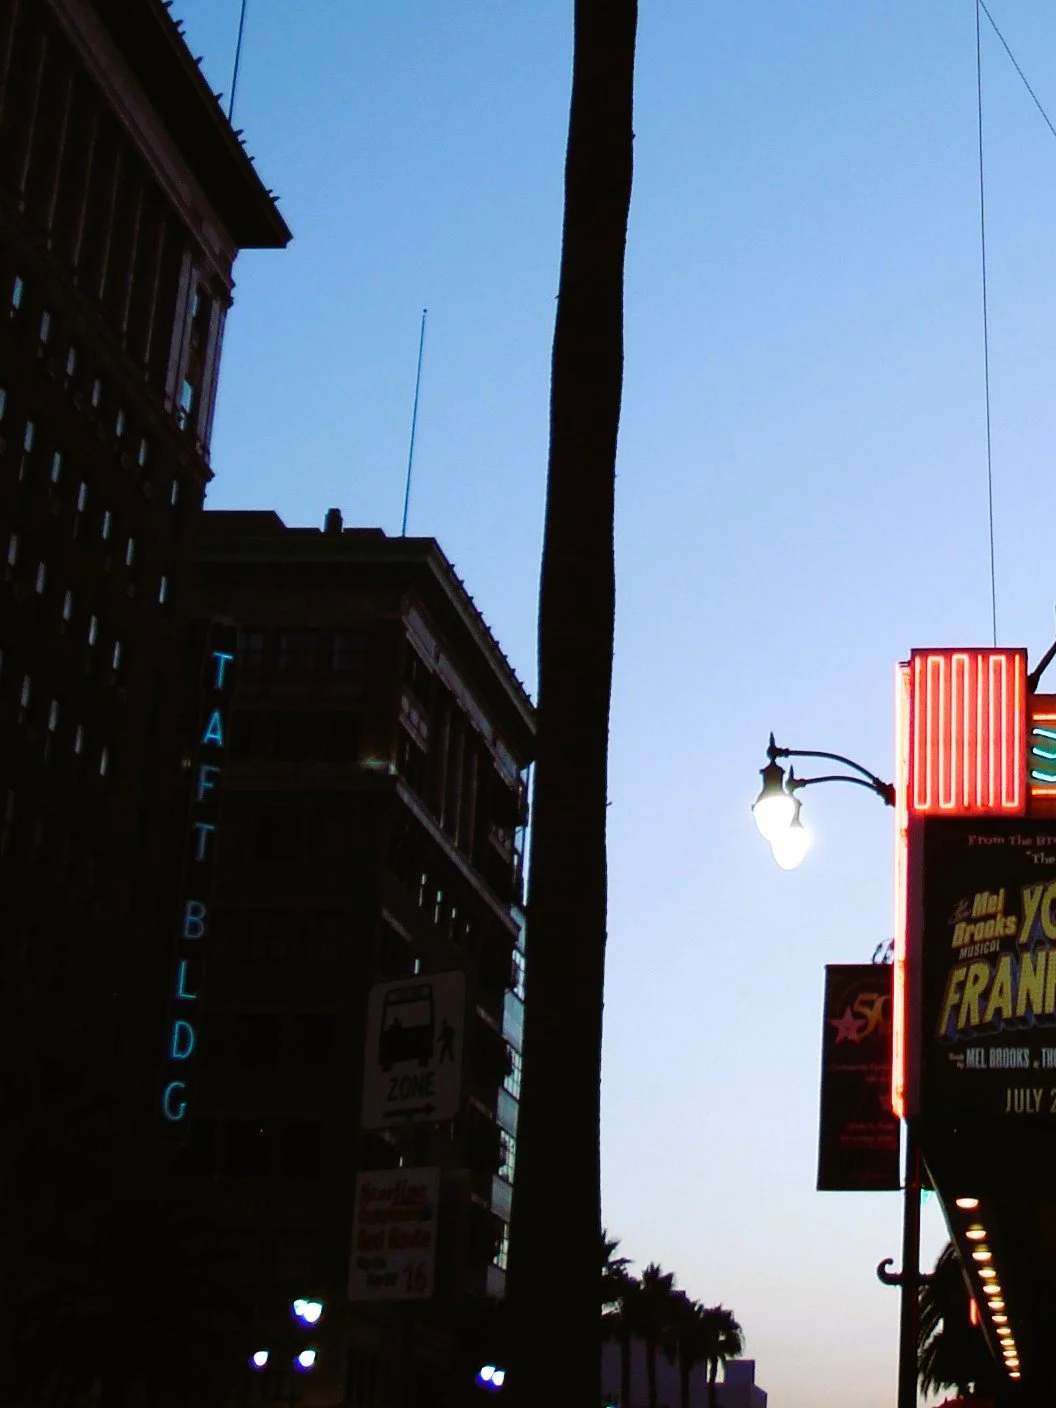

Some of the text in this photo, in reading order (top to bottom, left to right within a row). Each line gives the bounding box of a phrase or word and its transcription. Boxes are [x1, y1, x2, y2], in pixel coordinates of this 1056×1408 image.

[1008, 834, 1032, 847] The
[161, 649, 235, 1123] TAFT BLDG
[971, 887, 1006, 920] Mel
[951, 912, 1019, 950] Brooks
[966, 1046, 987, 1069] MEL
[989, 1046, 1030, 1069] BROOKS
[387, 1071, 436, 1102] ZONE
[1005, 1087, 1043, 1114] JULY
